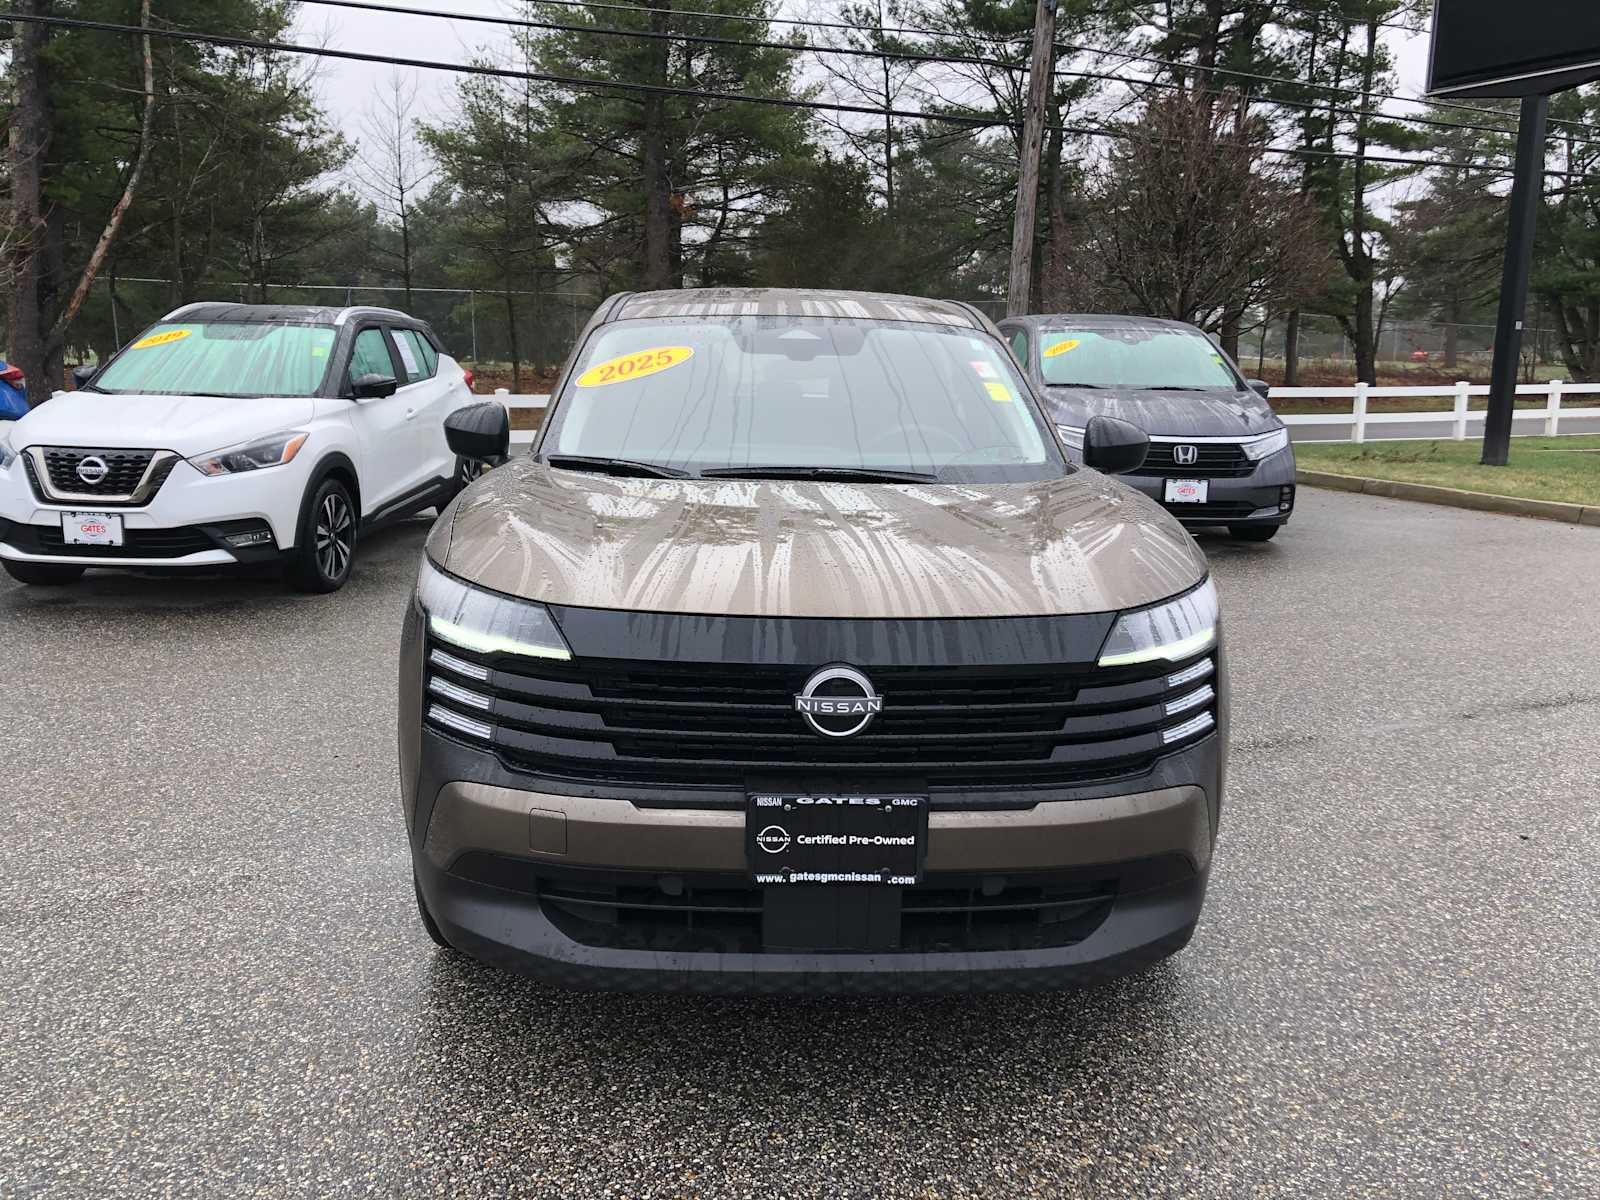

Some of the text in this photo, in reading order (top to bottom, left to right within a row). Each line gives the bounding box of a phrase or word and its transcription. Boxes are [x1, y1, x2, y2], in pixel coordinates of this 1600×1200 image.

[600, 350, 673, 382] 2025
[81, 524, 106, 534] GATES
[797, 699, 881, 713] NISSAN
[757, 797, 782, 806] NISSAN
[797, 834, 847, 845] Certified
[849, 835, 915, 845] Pre-Owned
[756, 872, 915, 885] www. gatesgmcnissan .com
